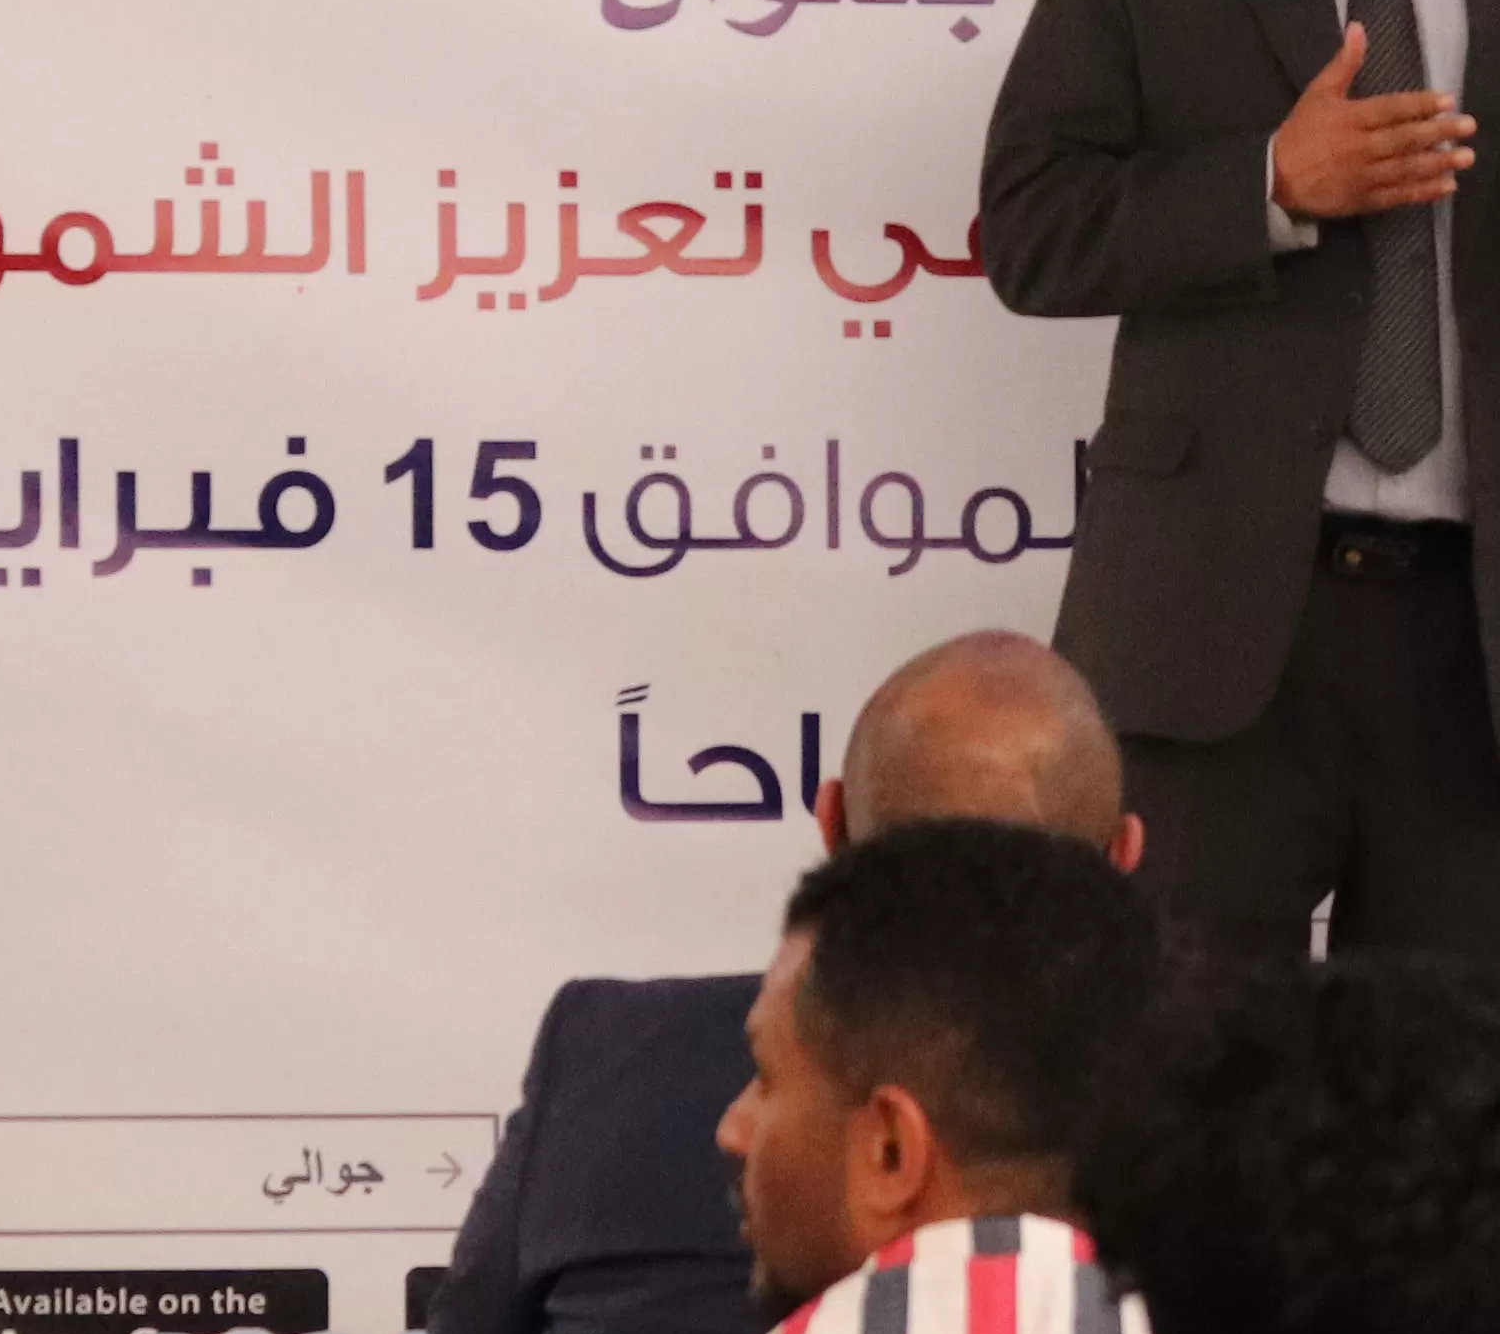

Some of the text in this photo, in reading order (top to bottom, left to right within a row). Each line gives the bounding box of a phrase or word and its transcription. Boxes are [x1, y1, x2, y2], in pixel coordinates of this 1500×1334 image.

[417, 168, 767, 312] تعزيز
[383, 435, 543, 554] 15
[582, 438, 1088, 578] لموافق
[261, 1146, 386, 1207] جوالي
[158, 1293, 201, 1315] on
[210, 1286, 267, 1315] the
